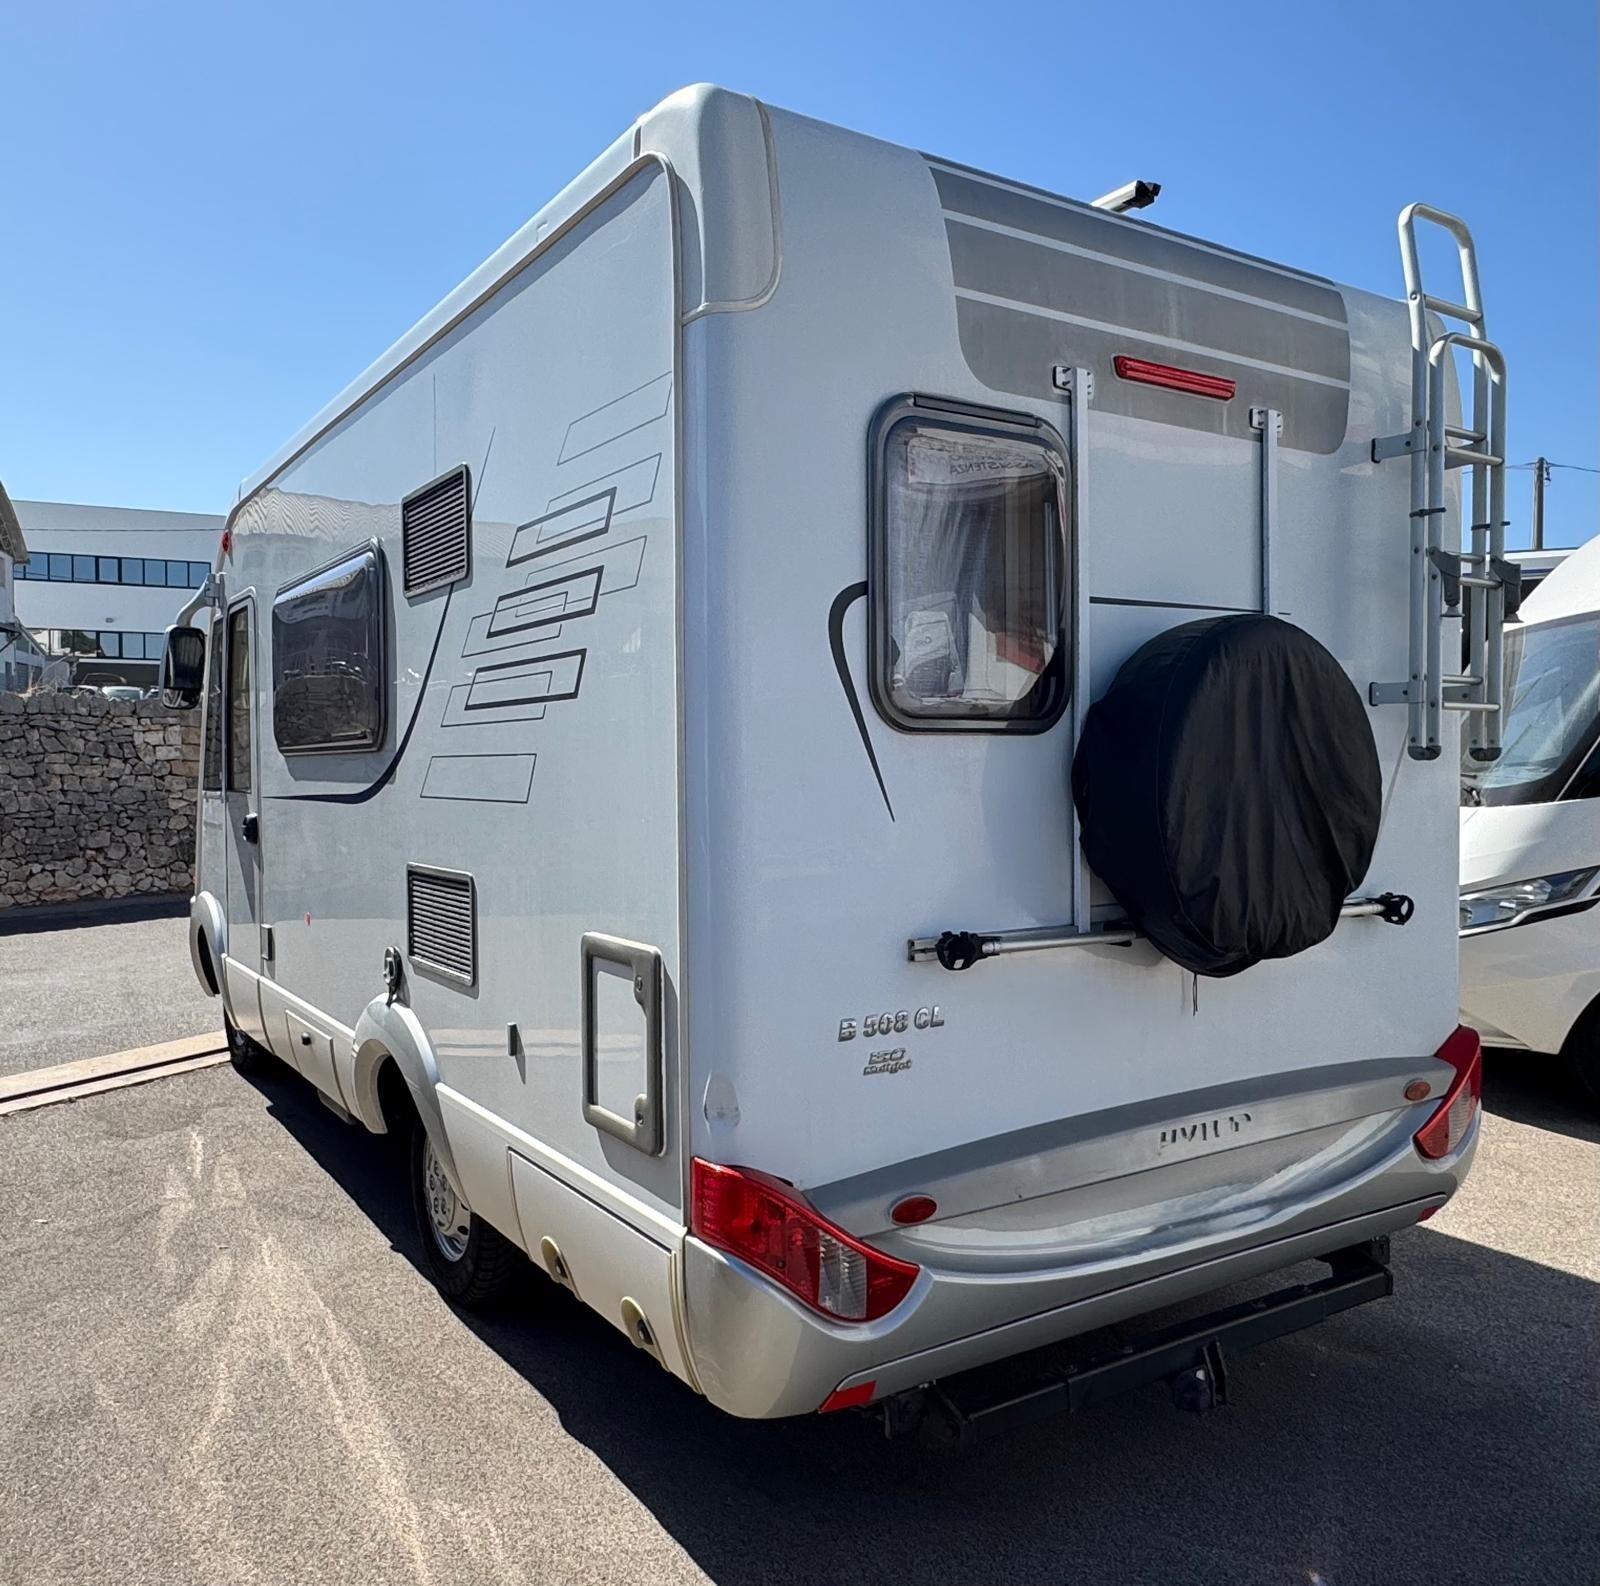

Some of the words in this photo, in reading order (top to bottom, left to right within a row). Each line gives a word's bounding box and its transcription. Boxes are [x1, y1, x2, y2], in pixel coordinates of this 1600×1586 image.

[838, 1018, 857, 1042] B
[863, 1010, 909, 1038] 508
[914, 1005, 945, 1030] CL
